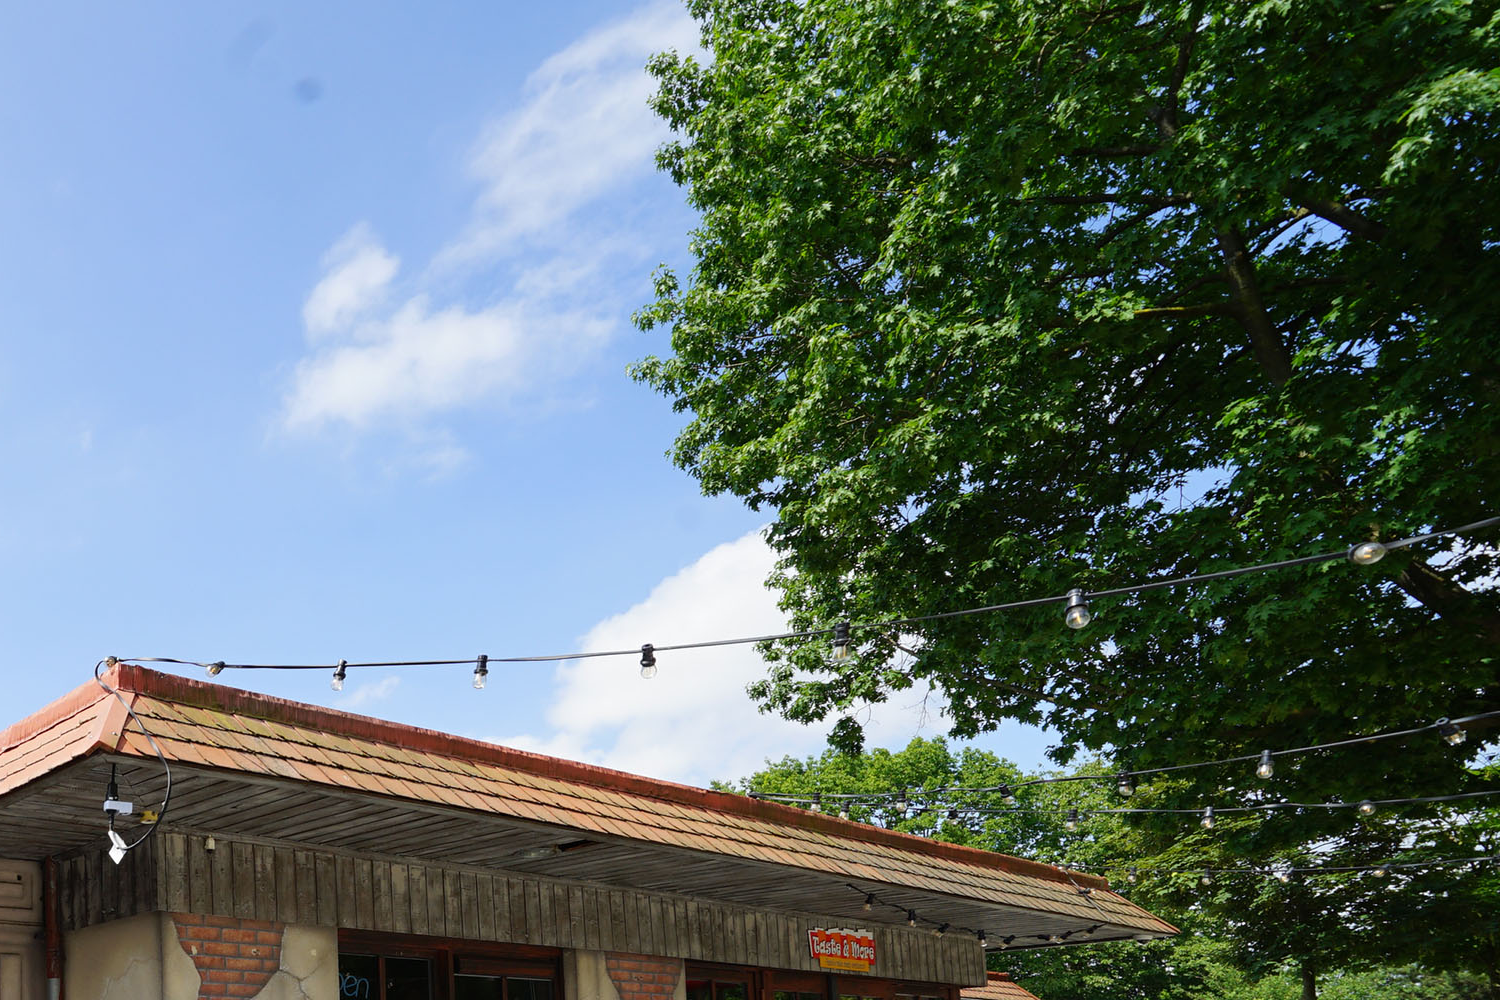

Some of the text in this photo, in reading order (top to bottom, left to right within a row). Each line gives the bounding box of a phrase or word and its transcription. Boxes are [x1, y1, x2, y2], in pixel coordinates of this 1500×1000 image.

[813, 936, 875, 960] Taste & More
